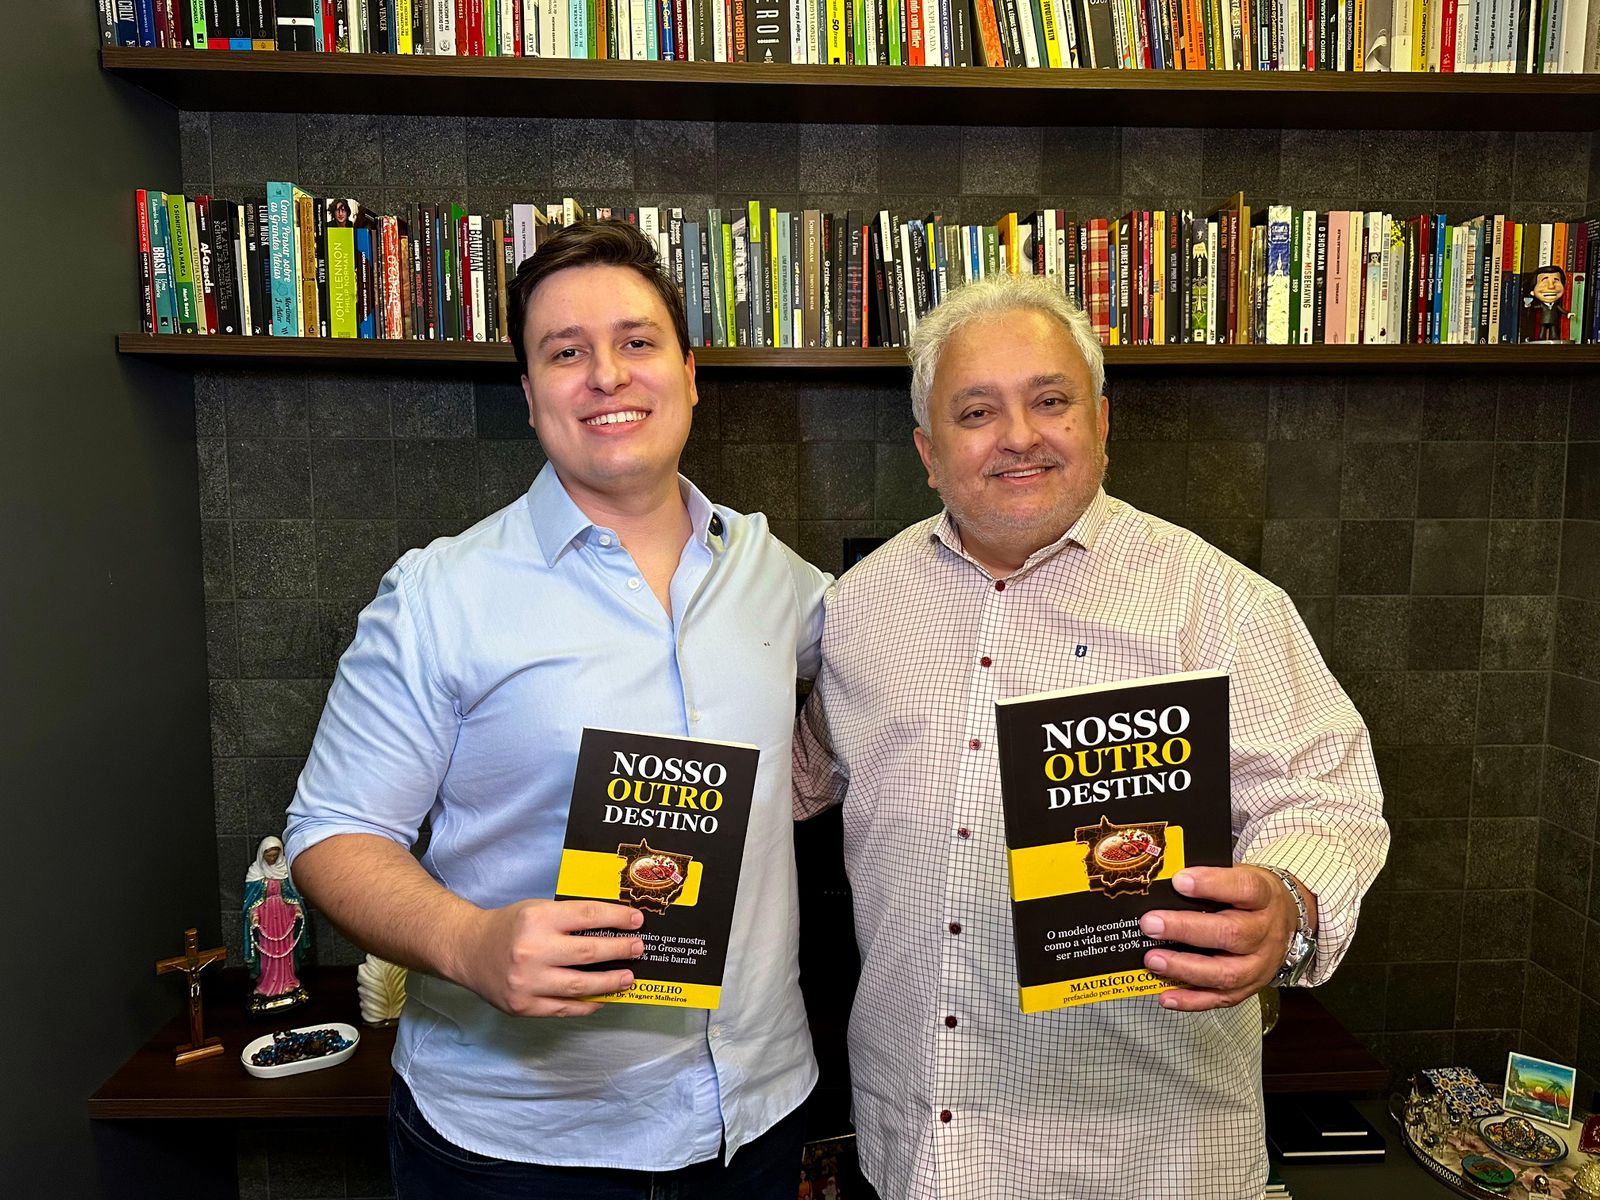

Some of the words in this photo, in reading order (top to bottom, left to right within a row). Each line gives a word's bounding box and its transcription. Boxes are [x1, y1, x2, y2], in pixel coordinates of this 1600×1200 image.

[735, 1, 743, 14] DOS
[1043, 1, 1054, 28] FIDELIDADE
[735, 15, 745, 50] GUERRA
[832, 18, 839, 31] 50
[911, 14, 919, 28] com
[928, 5, 937, 52] EXPLICADA
[1233, 20, 1241, 39] ELISE
[911, 30, 921, 48] Hitler
[1046, 29, 1055, 41] ALTA
[259, 205, 269, 223] ELON
[271, 202, 277, 213] as
[280, 200, 290, 224] Como
[174, 210, 182, 245] SIGNIFICADO
[260, 226, 270, 246] MUSK
[269, 214, 281, 250] Grandes
[177, 246, 183, 255] DA
[282, 226, 290, 258] Pensar
[470, 230, 483, 271] BAUMAN
[1317, 233, 1325, 271] SHOWMAN
[153, 247, 167, 276] BRASIL
[178, 256, 186, 277] MARCA
[200, 242, 214, 294] Al-Qaeda
[273, 253, 283, 279] Ideias
[283, 259, 292, 282] sobre
[334, 242, 343, 289] LENNON
[896, 265, 905, 313] AUTOBIOGRAFIA
[1303, 262, 1312, 308] MISBEHAVING
[335, 293, 345, 323] JOHN
[703, 300, 711, 314] HITLER
[1041, 705, 1191, 752] NOSSO
[610, 751, 727, 787] NOSSO
[1044, 736, 1192, 782] OUTRO
[606, 778, 723, 812] OUTRO
[1047, 769, 1192, 810] DESTINO
[602, 804, 718, 834] DESTINO
[661, 935, 677, 946] que
[678, 937, 706, 946] mostra
[1044, 941, 1071, 952] como
[1081, 936, 1102, 946] vida
[1104, 934, 1119, 942] em
[1047, 931, 1056, 940] O
[1058, 924, 1094, 938] modelo
[658, 944, 686, 954] Grosso
[687, 947, 708, 956] pode
[671, 956, 696, 965] barata
[1056, 952, 1071, 961] ser
[1074, 945, 1108, 958] melhor
[1118, 940, 1140, 952] 30%
[640, 984, 682, 994] COELHO
[1063, 990, 1098, 1004] prefaciado
[1100, 990, 1111, 998] por
[1126, 983, 1157, 994] Wagner
[1070, 974, 1135, 992] MAURÍCIO
[628, 993, 653, 1001] Wagner
[654, 994, 687, 1003] Malheiros
